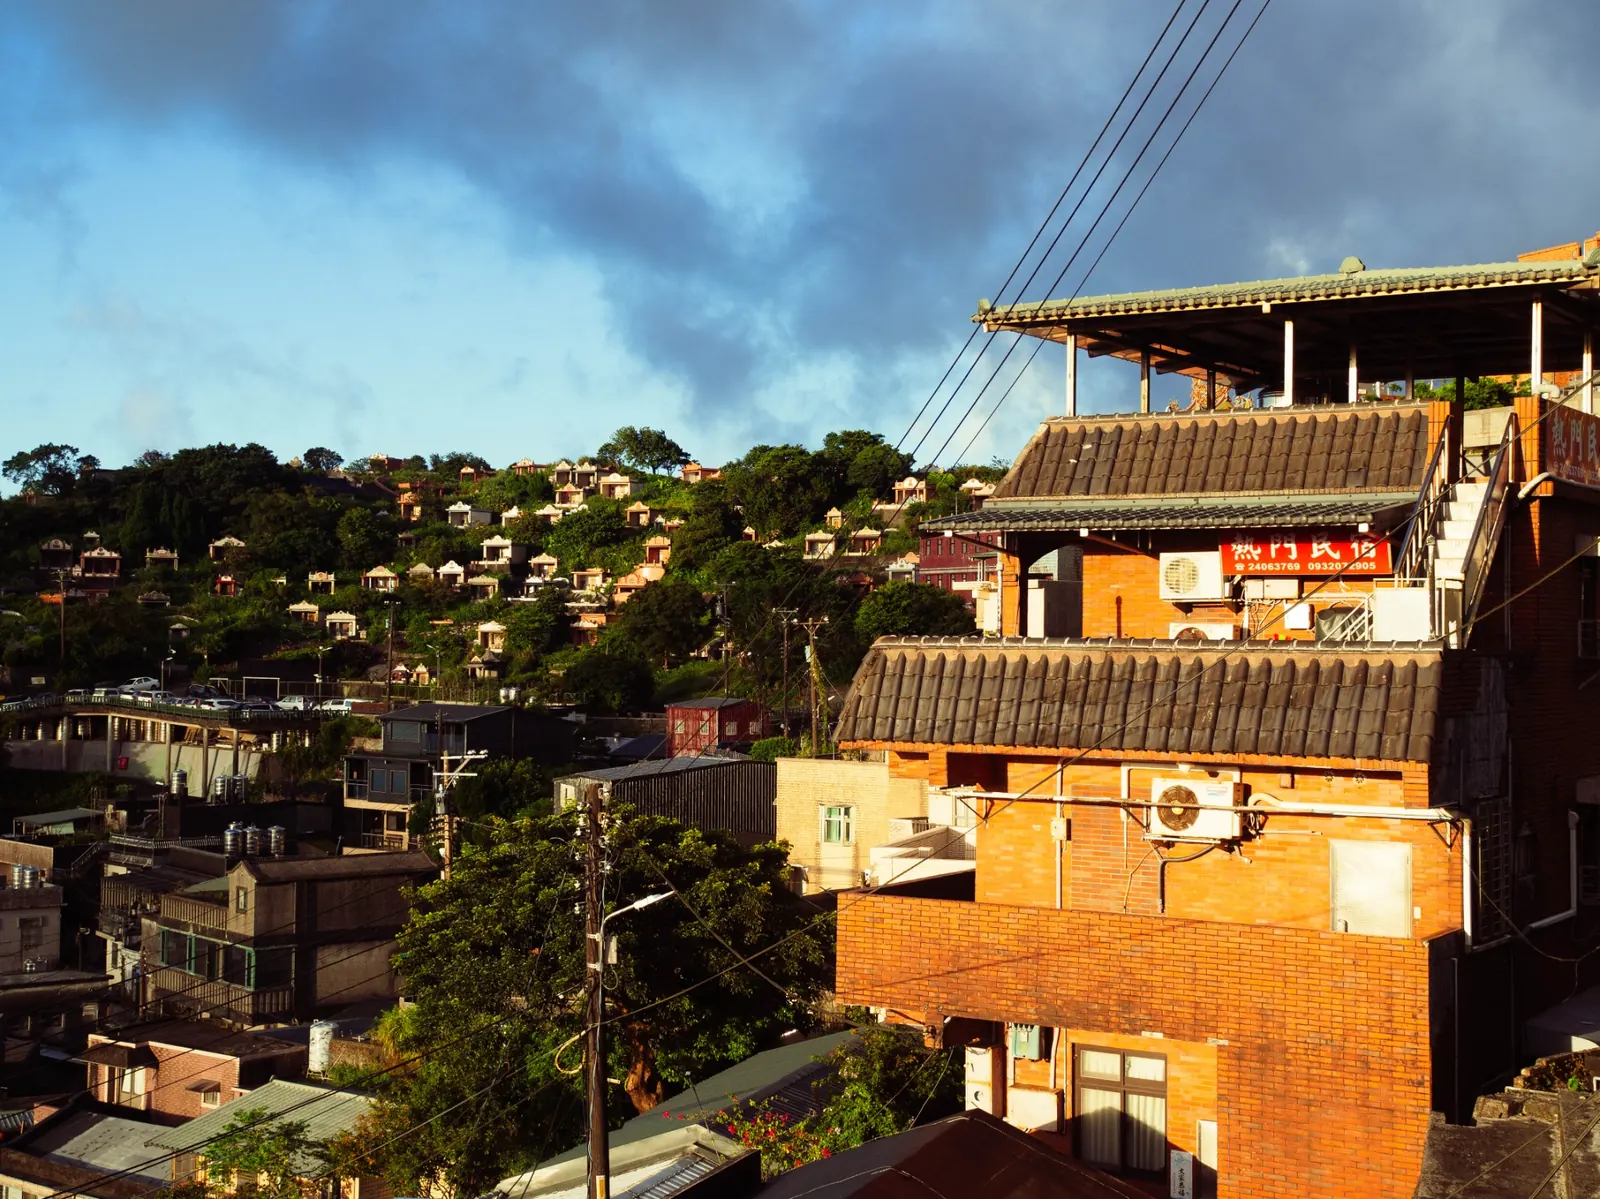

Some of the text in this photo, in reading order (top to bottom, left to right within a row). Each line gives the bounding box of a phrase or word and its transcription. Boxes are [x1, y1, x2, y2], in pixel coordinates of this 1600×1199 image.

[1230, 532, 1376, 561] 熱門民宿
[1248, 562, 1301, 571] 24063769
